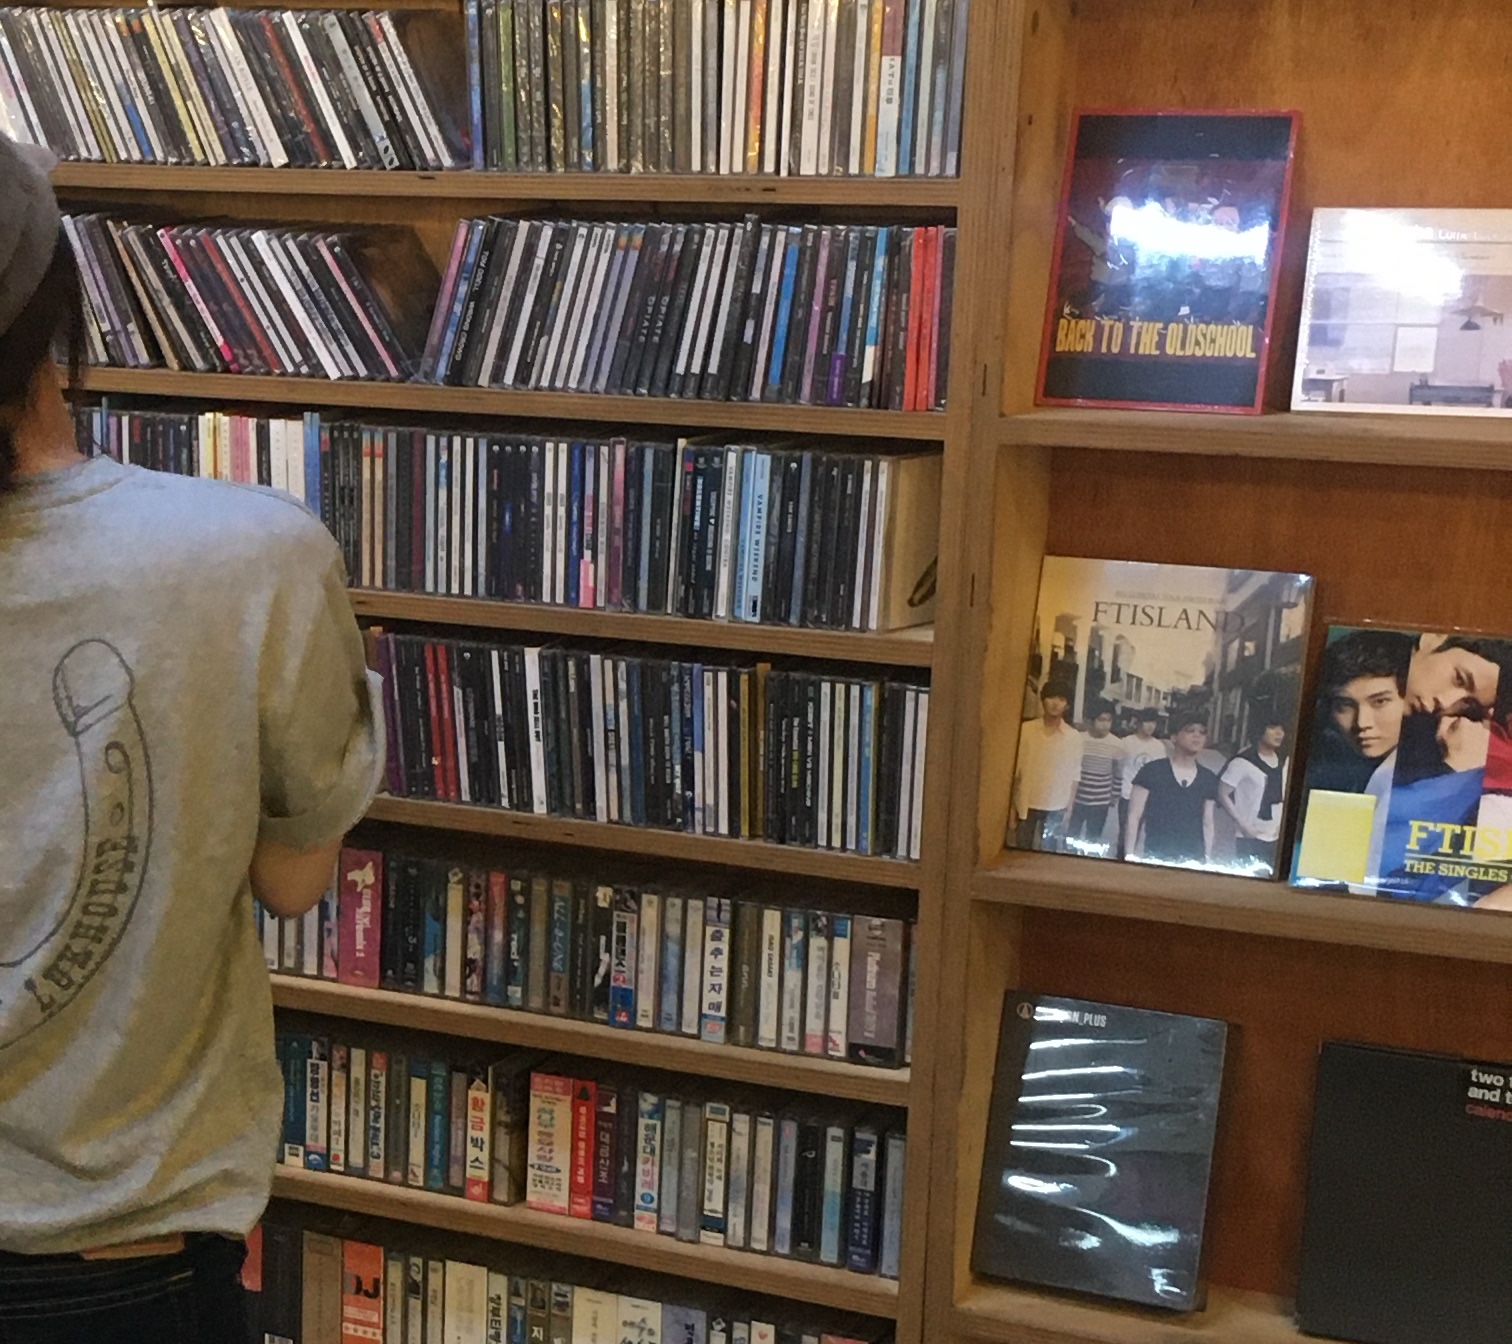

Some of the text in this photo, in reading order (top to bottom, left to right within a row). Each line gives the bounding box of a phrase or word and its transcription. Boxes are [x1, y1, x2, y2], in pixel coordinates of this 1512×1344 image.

[638, 295, 656, 344] OPIATE
[652, 295, 670, 344] OPIATE
[1055, 318, 1257, 359] BACK TO THE OLDSCHOOL
[751, 494, 764, 583] VAMPIRE WEEKEND
[1091, 600, 1246, 634] FTISLAND
[1404, 858, 1509, 883] THE SINGLES
[1467, 1086, 1501, 1103] and
[1471, 1068, 1505, 1087] two
[470, 1095, 486, 1171] 황금박스
[344, 1269, 382, 1300] DJ
